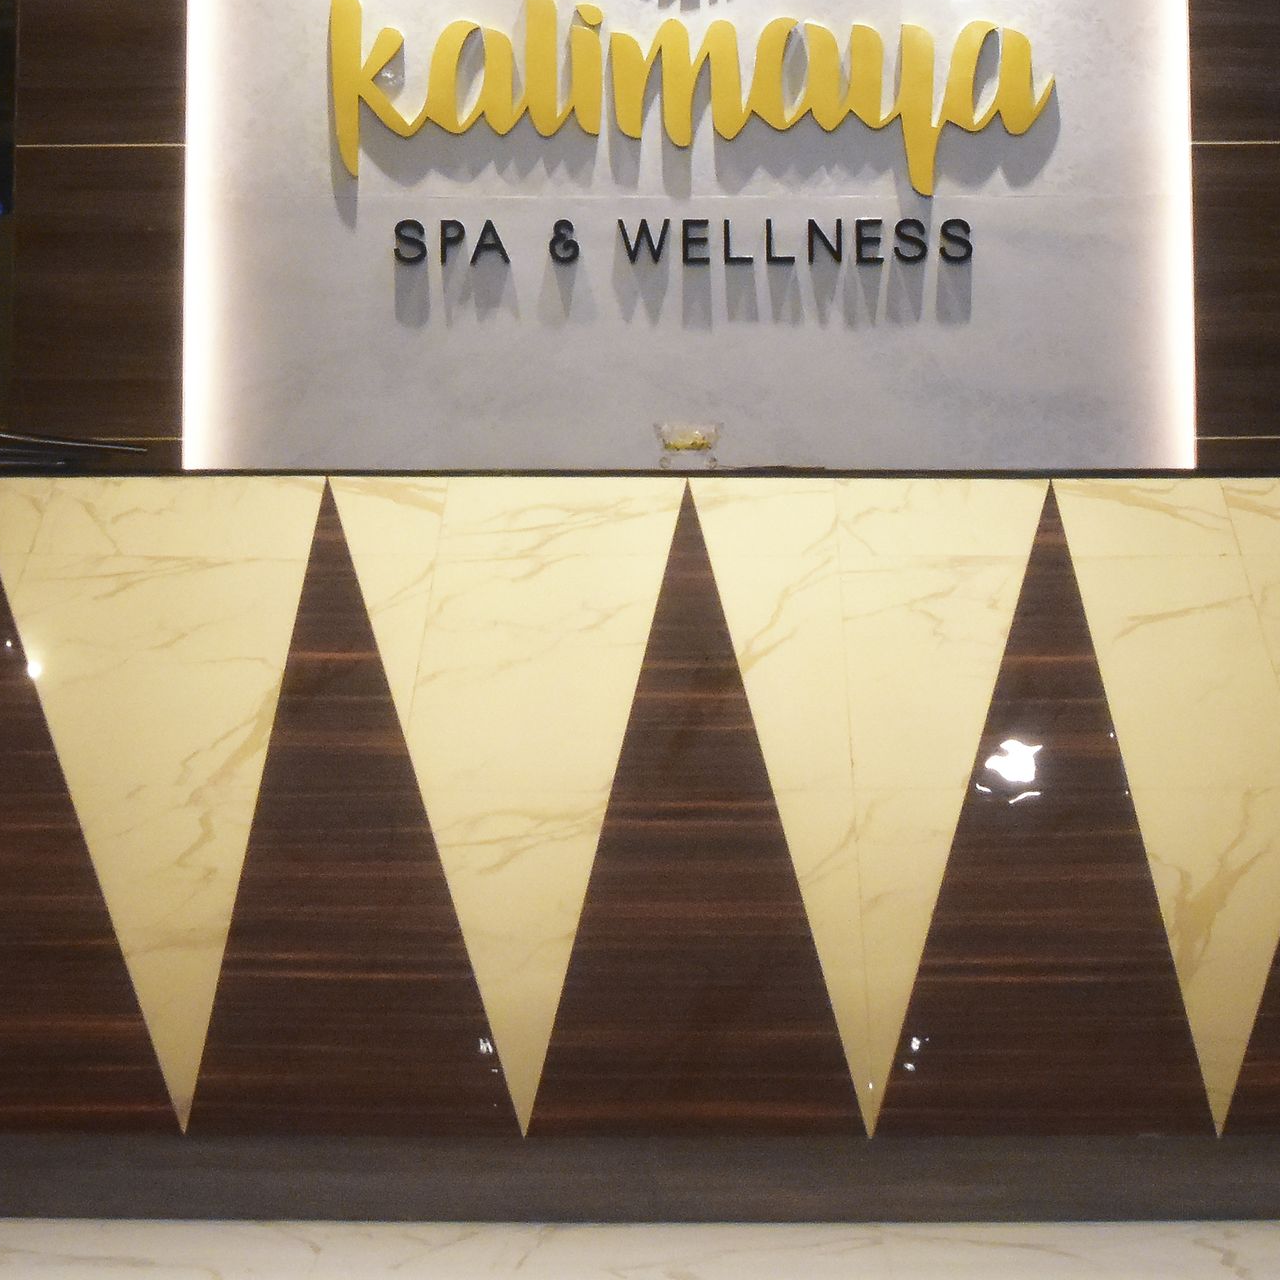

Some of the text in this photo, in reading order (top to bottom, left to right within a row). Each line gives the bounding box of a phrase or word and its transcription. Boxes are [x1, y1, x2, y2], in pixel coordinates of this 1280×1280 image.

[393, 218, 974, 266] SPA & WELLNESS
